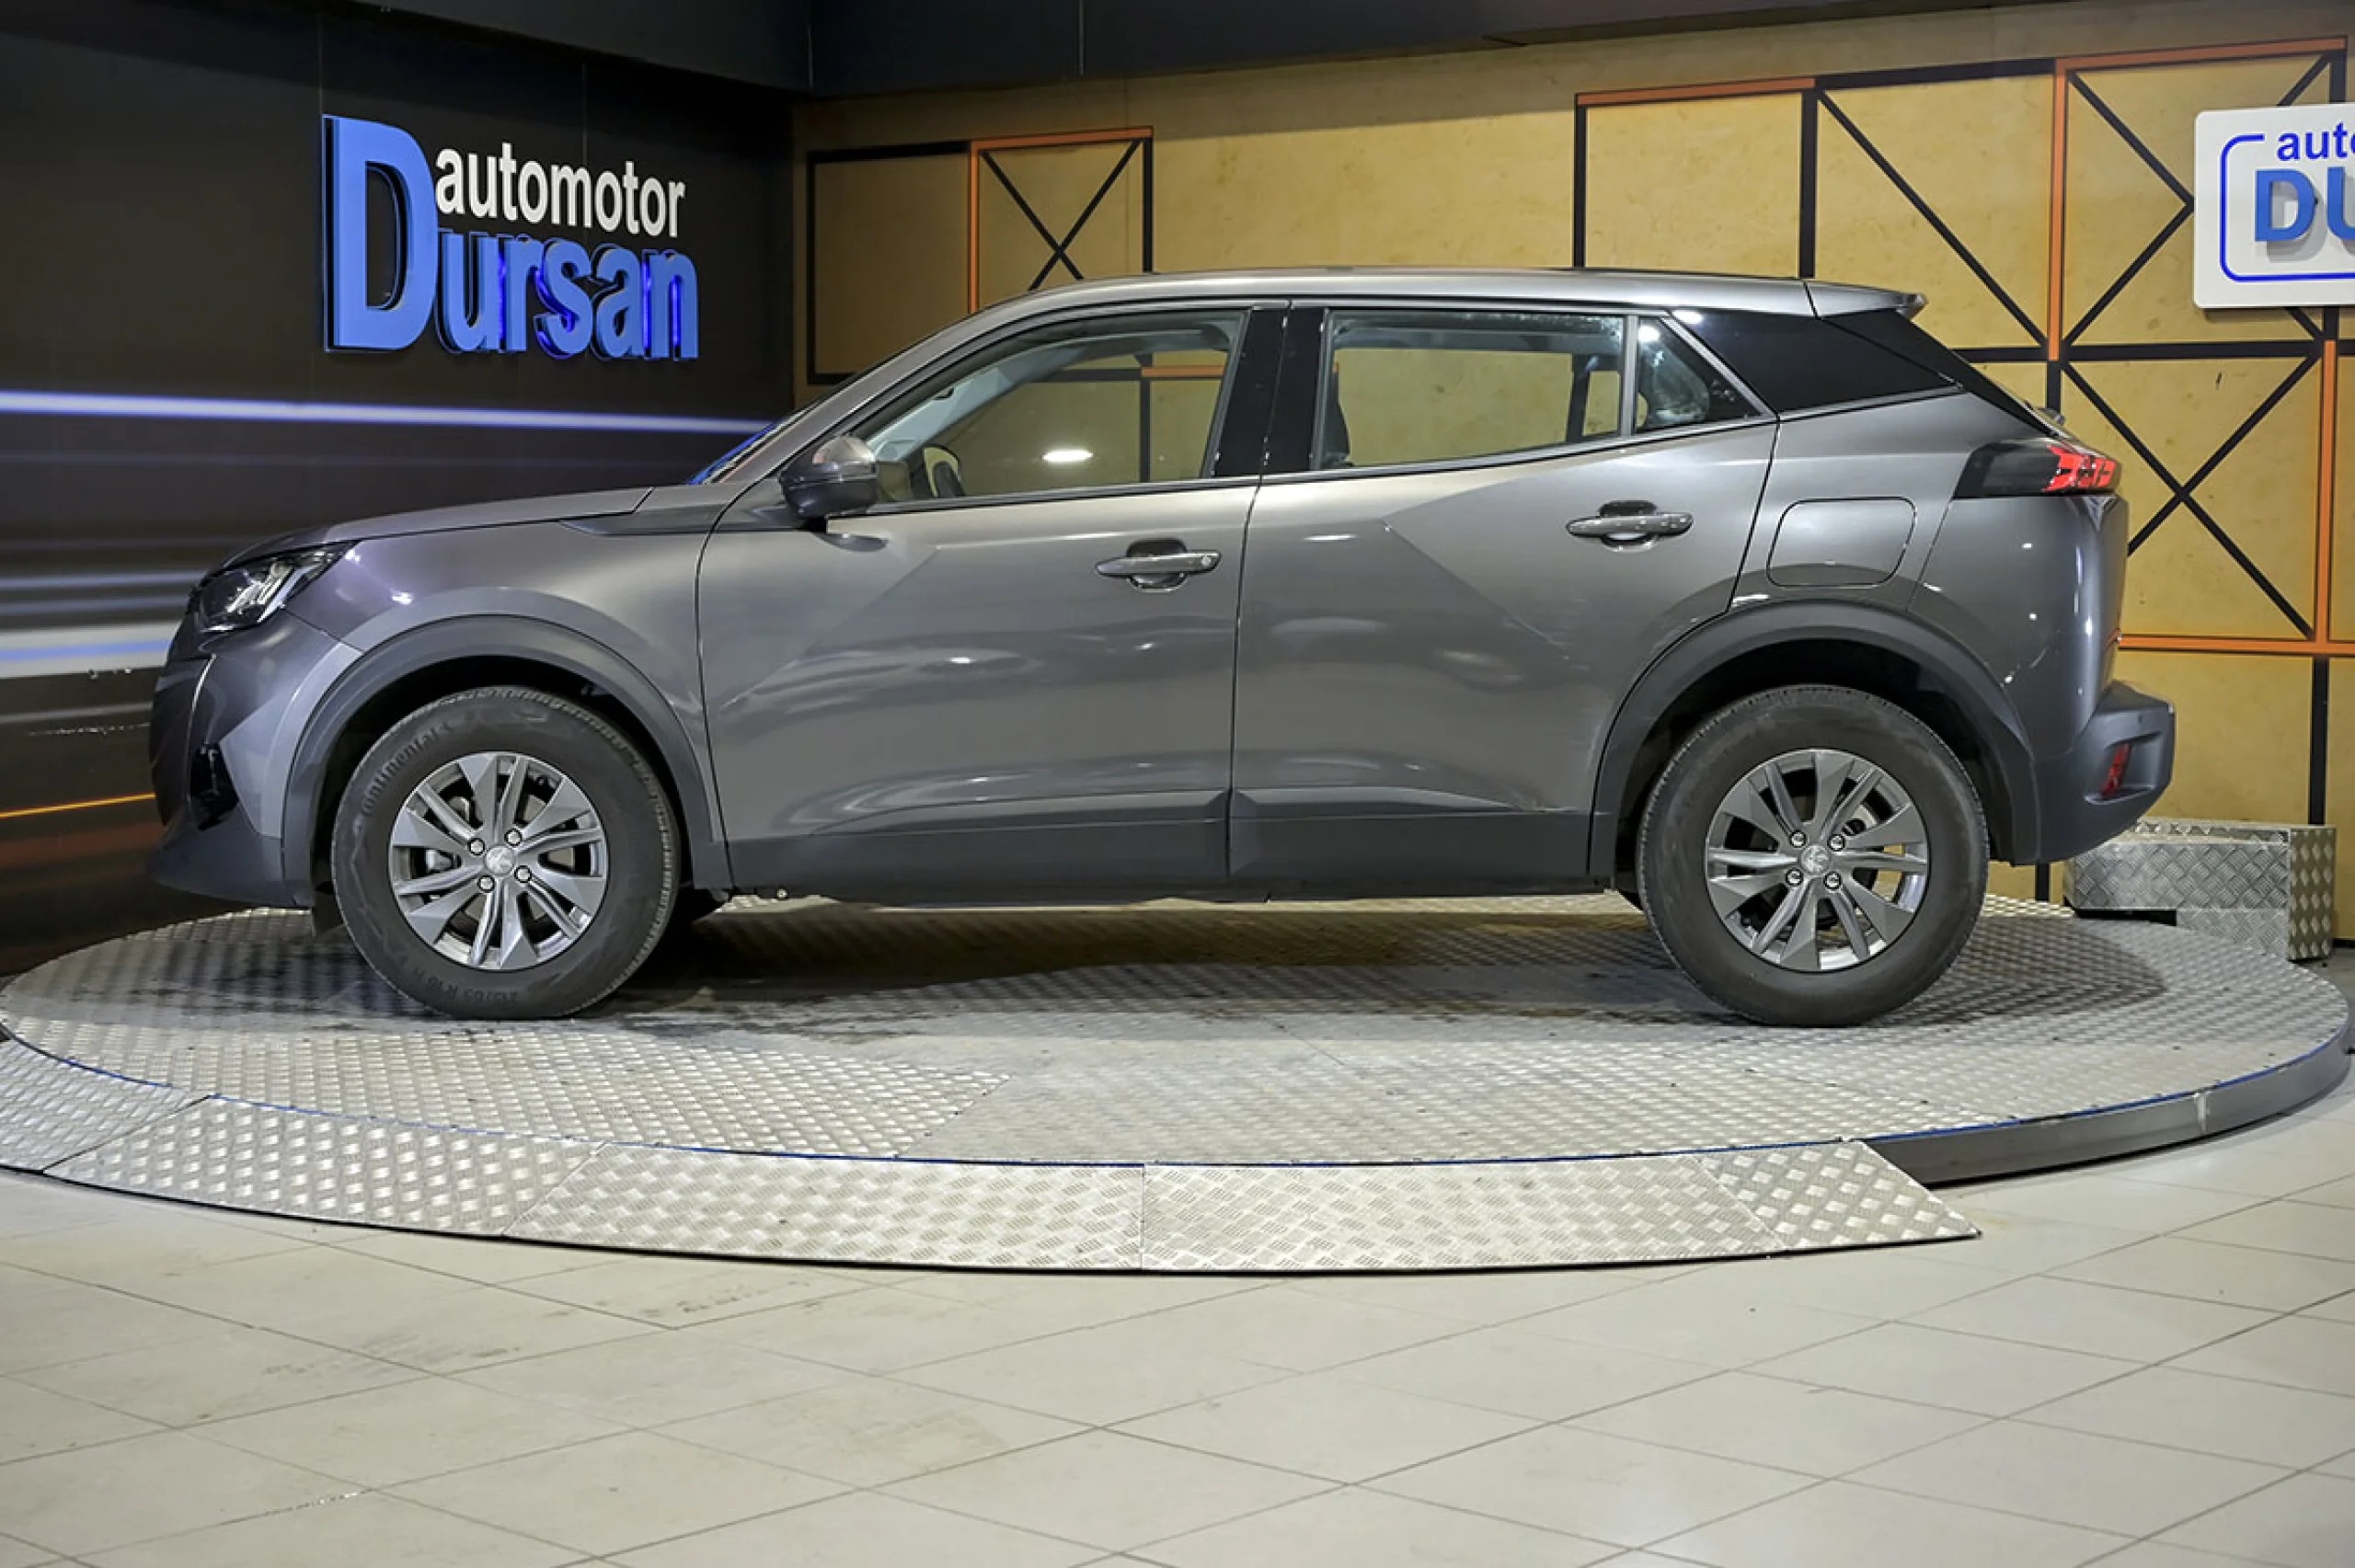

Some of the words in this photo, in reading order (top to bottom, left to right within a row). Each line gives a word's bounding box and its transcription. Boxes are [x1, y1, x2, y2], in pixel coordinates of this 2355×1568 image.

[2276, 120, 2355, 162] aut
[322, 113, 700, 361] Dursan
[435, 142, 686, 238] automotor
